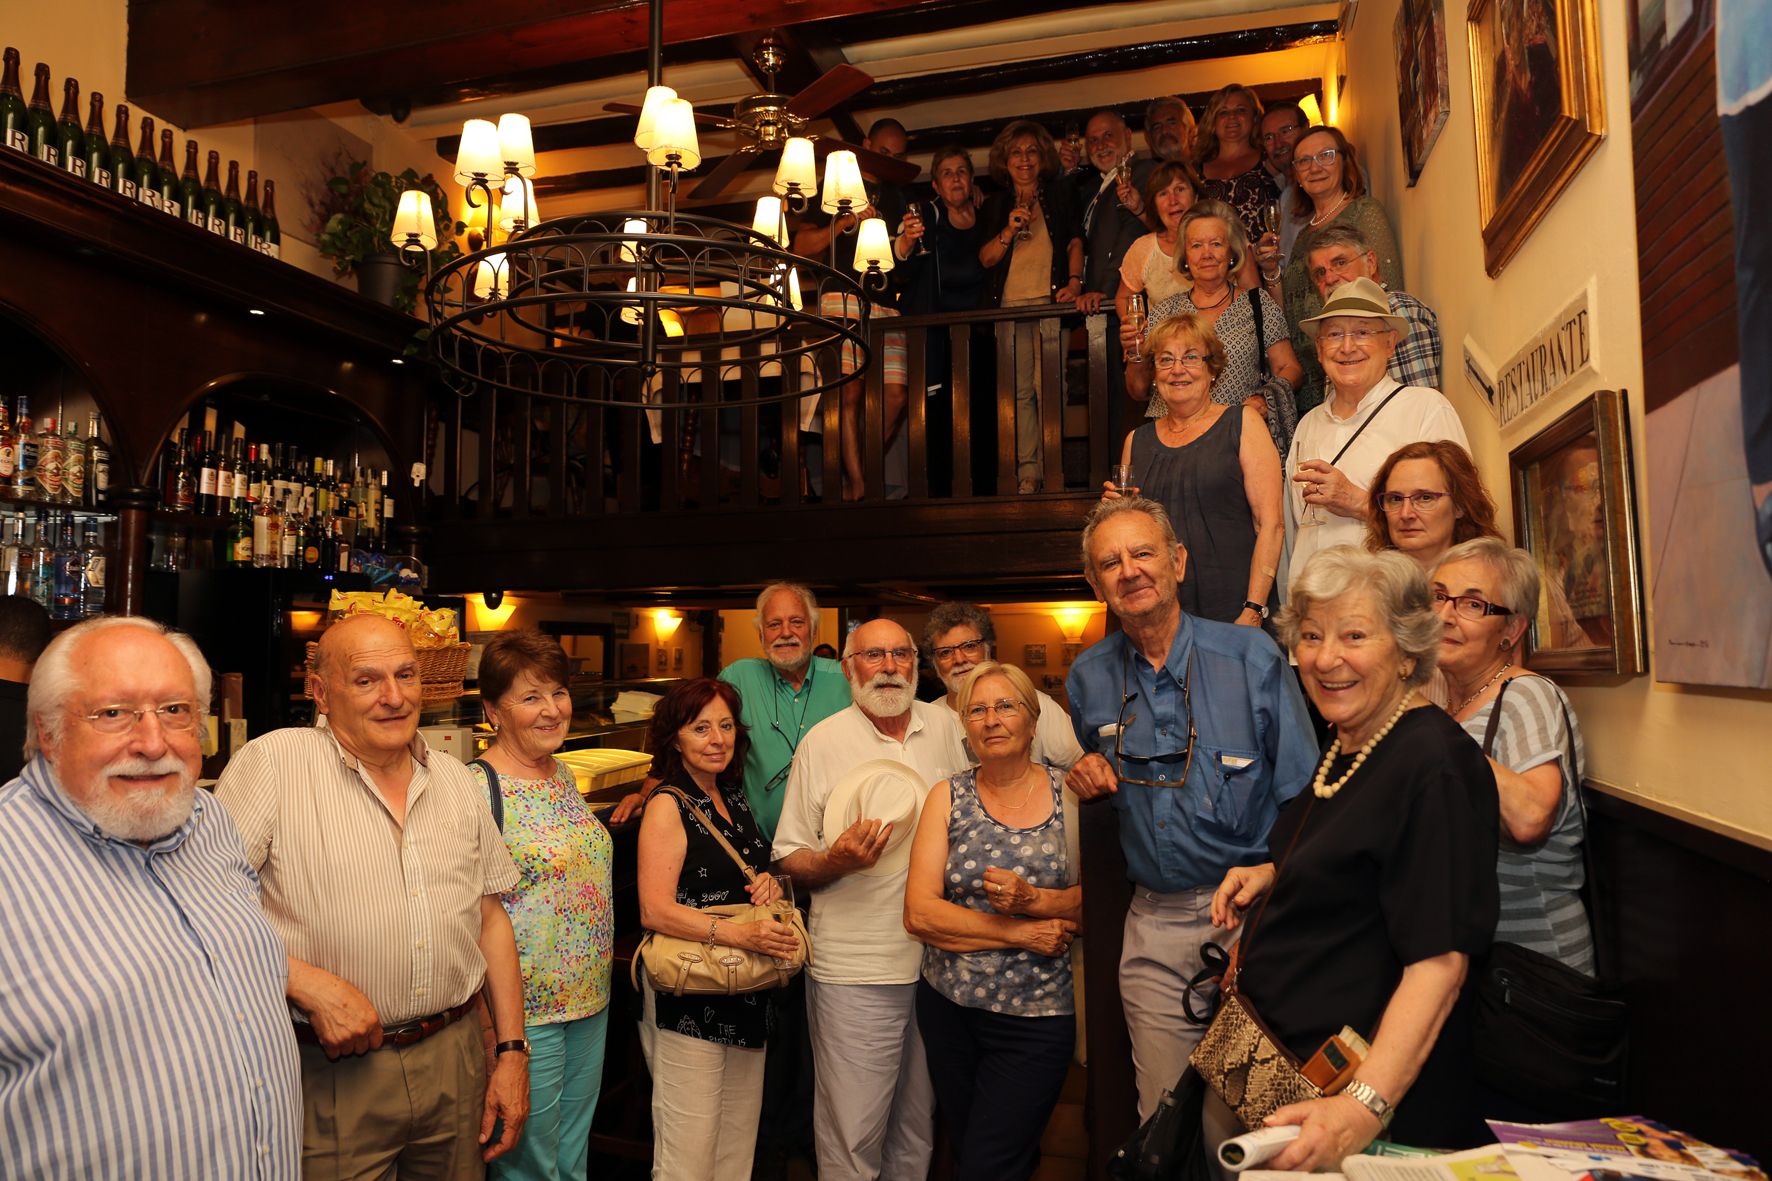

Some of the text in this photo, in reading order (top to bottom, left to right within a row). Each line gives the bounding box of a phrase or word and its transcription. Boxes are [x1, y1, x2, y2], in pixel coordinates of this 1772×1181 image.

[11, 129, 27, 153] R
[72, 156, 86, 178] R
[98, 168, 111, 189] R
[122, 179, 136, 199] R
[1498, 309, 1590, 427] RESTAURANTE
